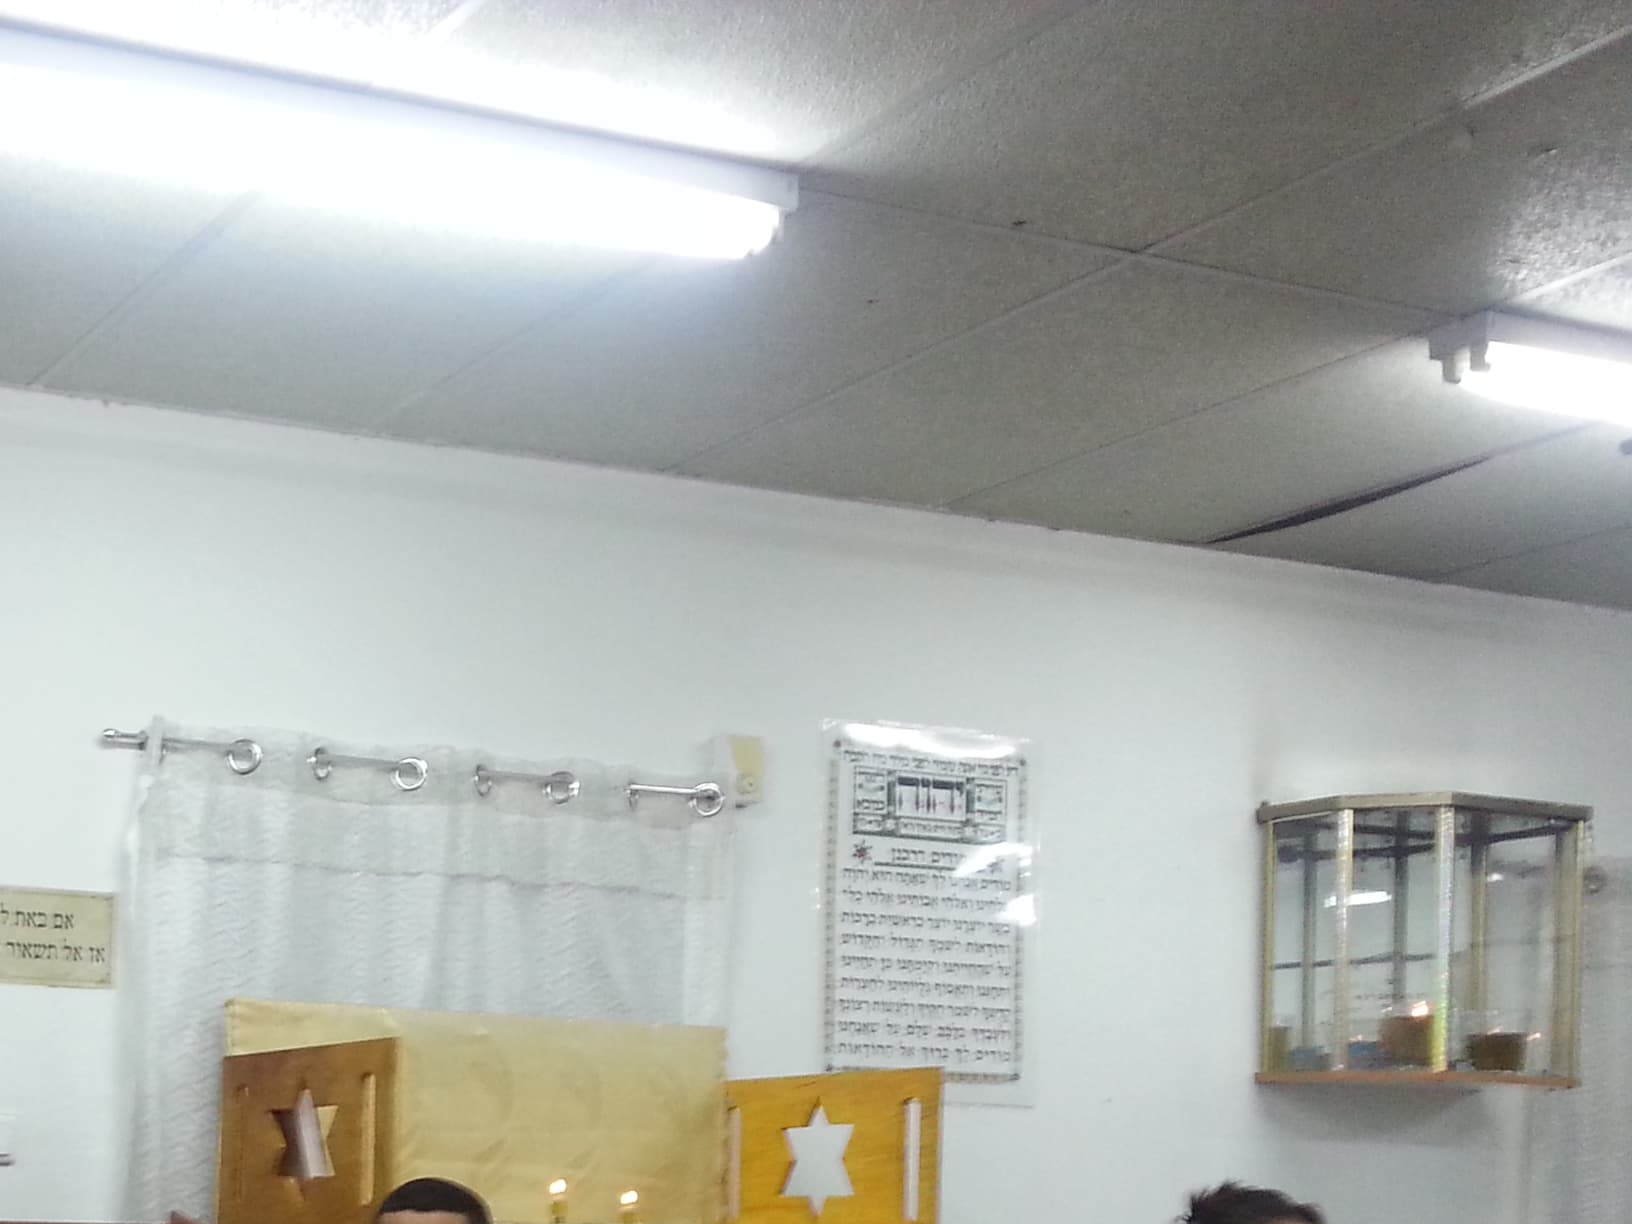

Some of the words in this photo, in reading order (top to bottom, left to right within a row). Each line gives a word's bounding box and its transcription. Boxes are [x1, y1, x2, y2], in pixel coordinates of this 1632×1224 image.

[15, 910, 47, 928] באת
[53, 912, 74, 930] אם
[6, 940, 58, 960] תשאיר
[63, 937, 83, 962] אל
[89, 945, 105, 963] אז
